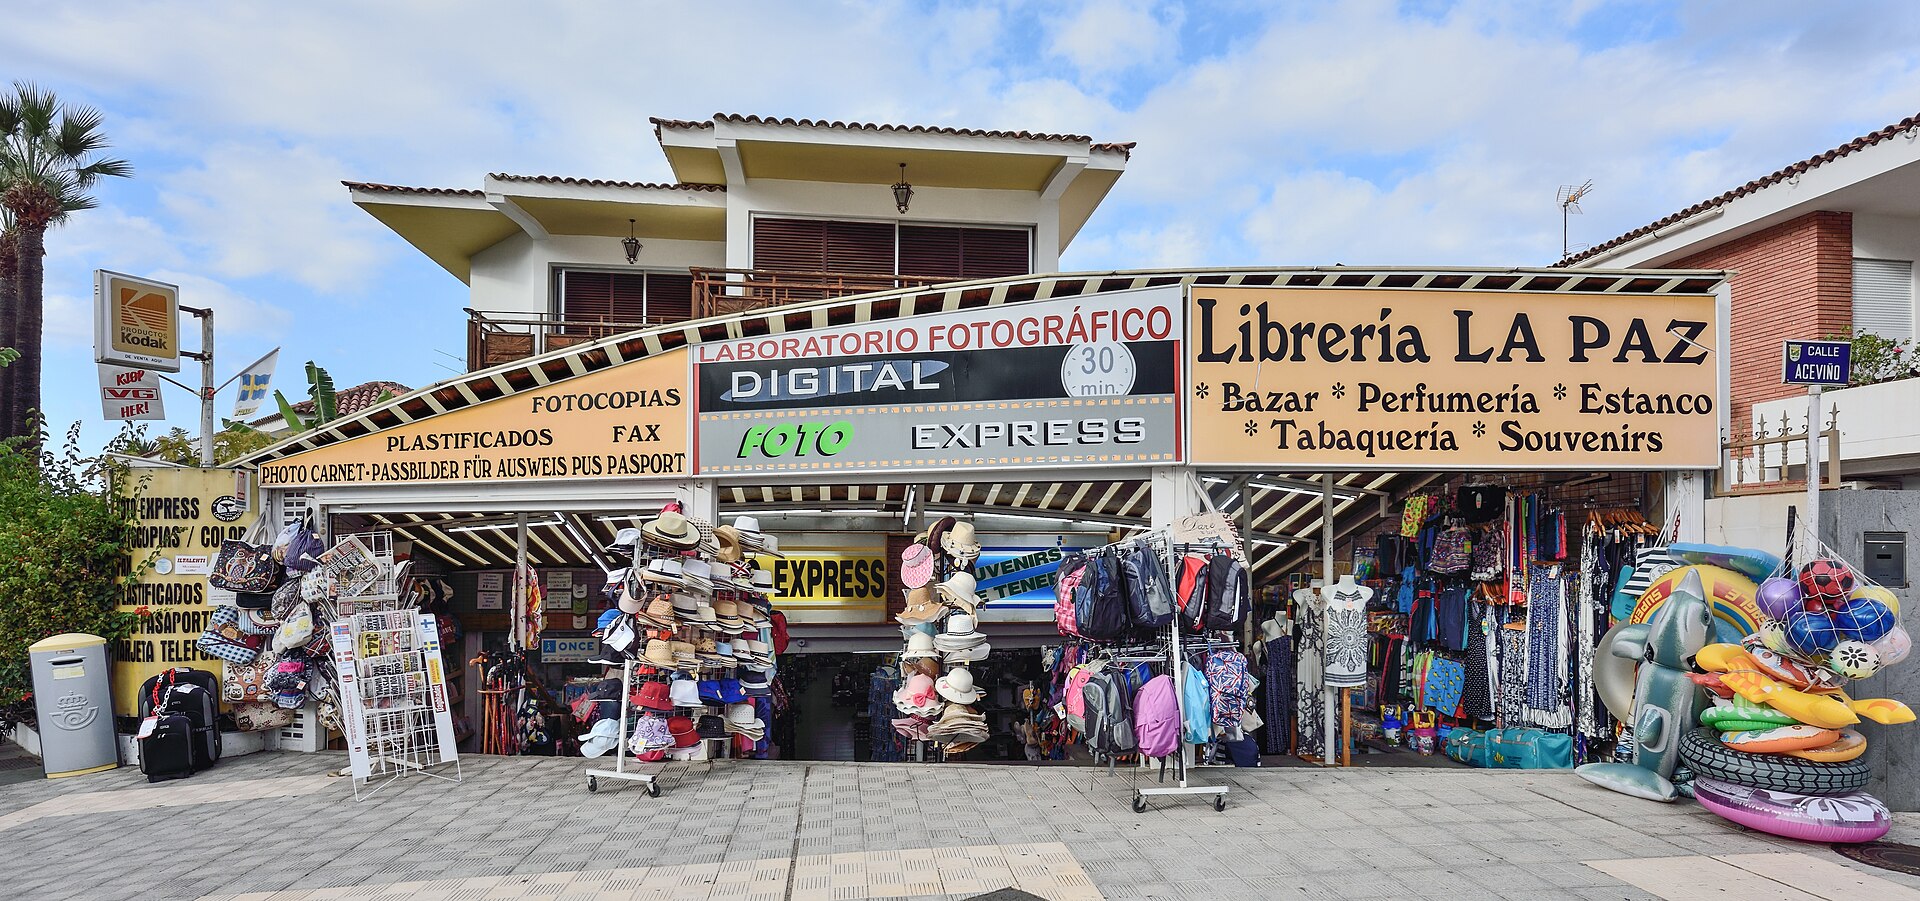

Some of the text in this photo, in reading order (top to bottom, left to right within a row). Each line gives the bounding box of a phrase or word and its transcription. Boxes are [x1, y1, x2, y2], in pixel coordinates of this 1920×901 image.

[120, 326, 168, 340] PRODUCTOS
[121, 332, 168, 350] Kodak
[699, 305, 1173, 363] LABORATORIO FOTOGRÁFICO
[1196, 298, 1710, 365] Librería LA PAZ
[1081, 346, 1114, 375] 30
[1808, 346, 1840, 357] CALLE
[116, 370, 145, 386] KJØP
[731, 361, 941, 398] DIGITAL
[1794, 362, 1840, 380] ACEVIÑO
[106, 389, 155, 399] VG
[531, 388, 681, 414] FOTOCOPIAS
[1080, 380, 1119, 396] min.
[1221, 381, 1714, 416] Bazar Perfumería Estanco
[120, 401, 150, 418] HER!
[386, 424, 660, 452] PLASTIFICADOS FAX
[737, 417, 1146, 459] FOTO EXPRESS
[1271, 419, 1664, 458] Tabaquería Souvenirs
[262, 463, 307, 484] PHOTO
[464, 454, 492, 478] FÜR
[496, 456, 567, 478] AUSWEIS
[572, 454, 602, 476] PUS
[607, 452, 686, 474] PASPORT
[140, 497, 200, 520] EXPRESS
[774, 559, 886, 598] EXPRESS
[1631, 588, 1663, 624] SUPER
[558, 642, 594, 650] ONCE
